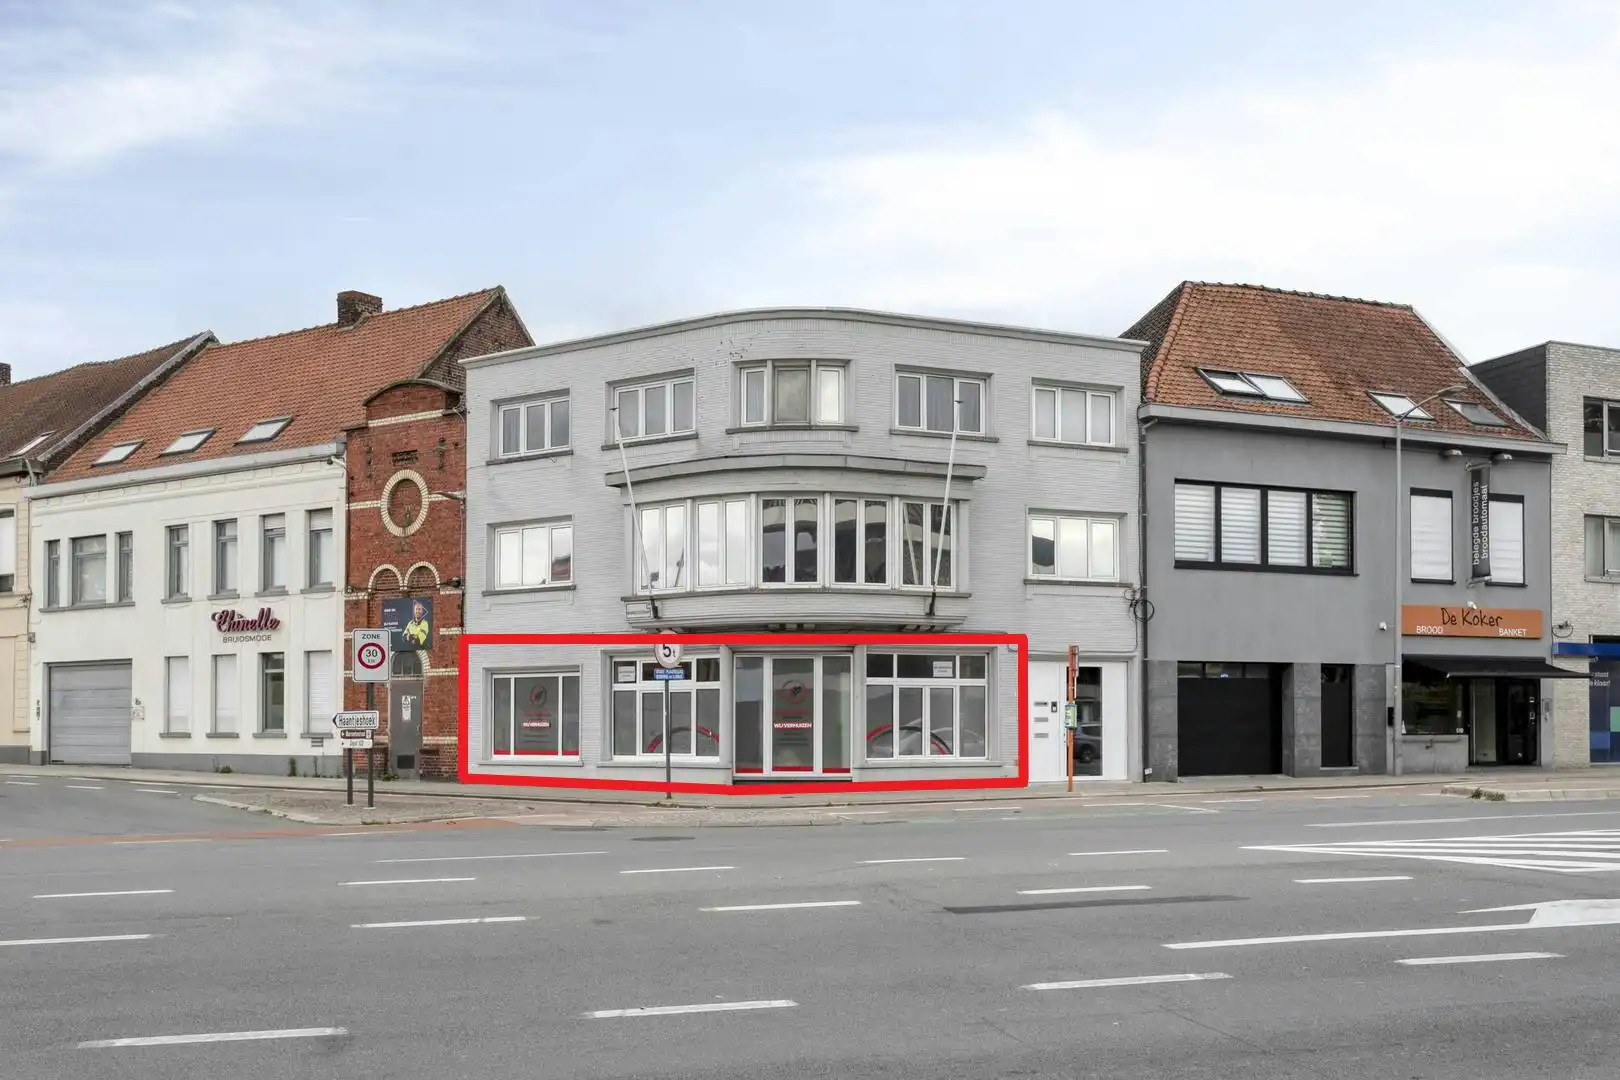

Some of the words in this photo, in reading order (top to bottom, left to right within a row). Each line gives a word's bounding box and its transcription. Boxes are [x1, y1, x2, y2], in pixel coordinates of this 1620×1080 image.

[1472, 481, 1480, 524] broodjes
[1472, 525, 1480, 565] belegde
[211, 608, 280, 632] Chinelle
[1441, 607, 1457, 625] De
[1461, 607, 1503, 627] Koker
[1416, 625, 1444, 634] BROOD
[1499, 627, 1527, 637] BANKET
[222, 634, 272, 643] BRUIDSMODE
[365, 649, 378, 658] 30
[338, 714, 377, 728] Haantjeshoek
